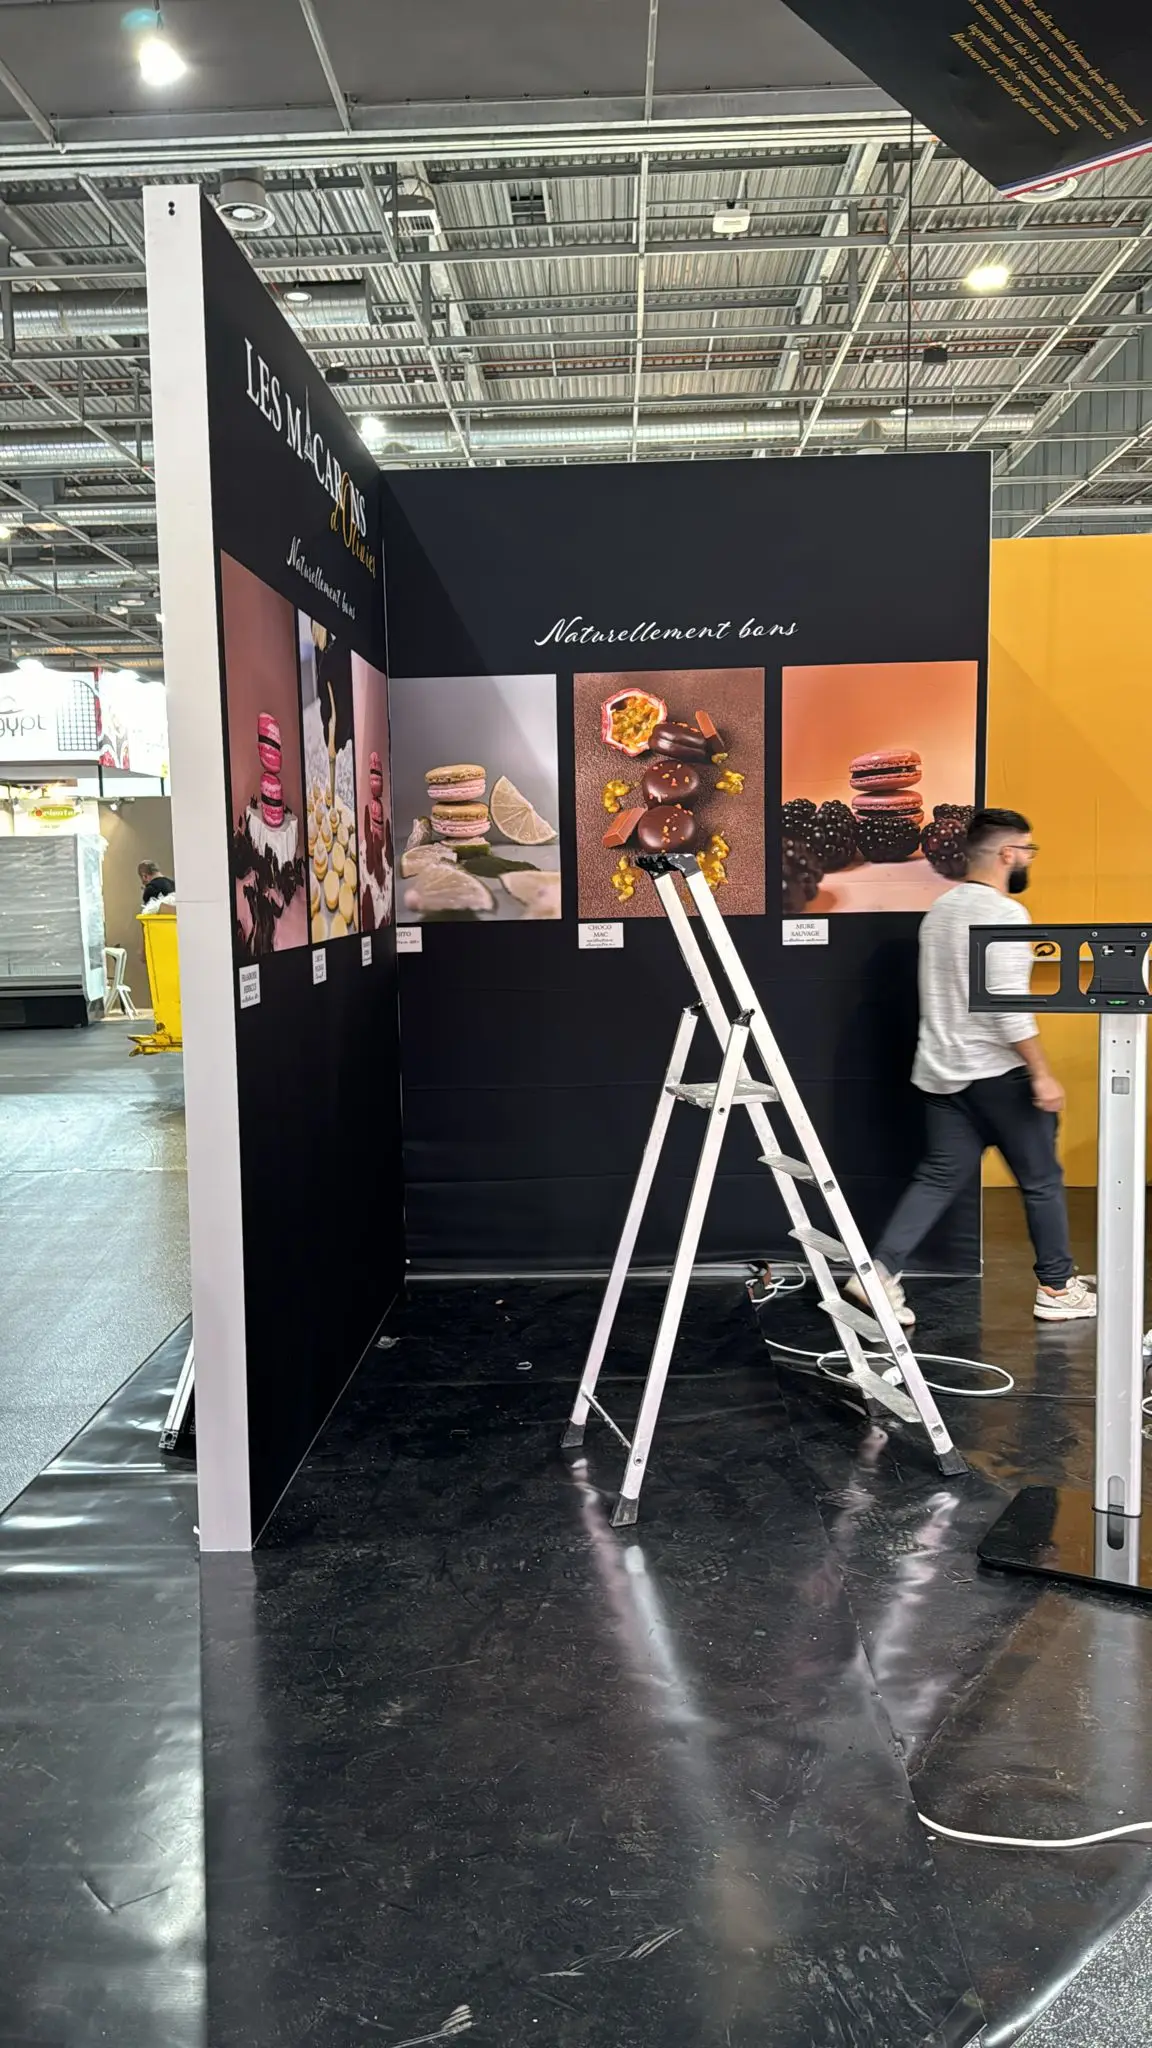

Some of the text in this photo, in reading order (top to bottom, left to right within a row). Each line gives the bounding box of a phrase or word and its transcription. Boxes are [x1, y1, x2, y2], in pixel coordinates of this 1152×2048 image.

[1050, 28, 1066, 43] nous
[245, 338, 367, 538] LES MACARONS
[286, 535, 355, 620] Naturellement bons
[534, 616, 799, 646] Naturellement bons
